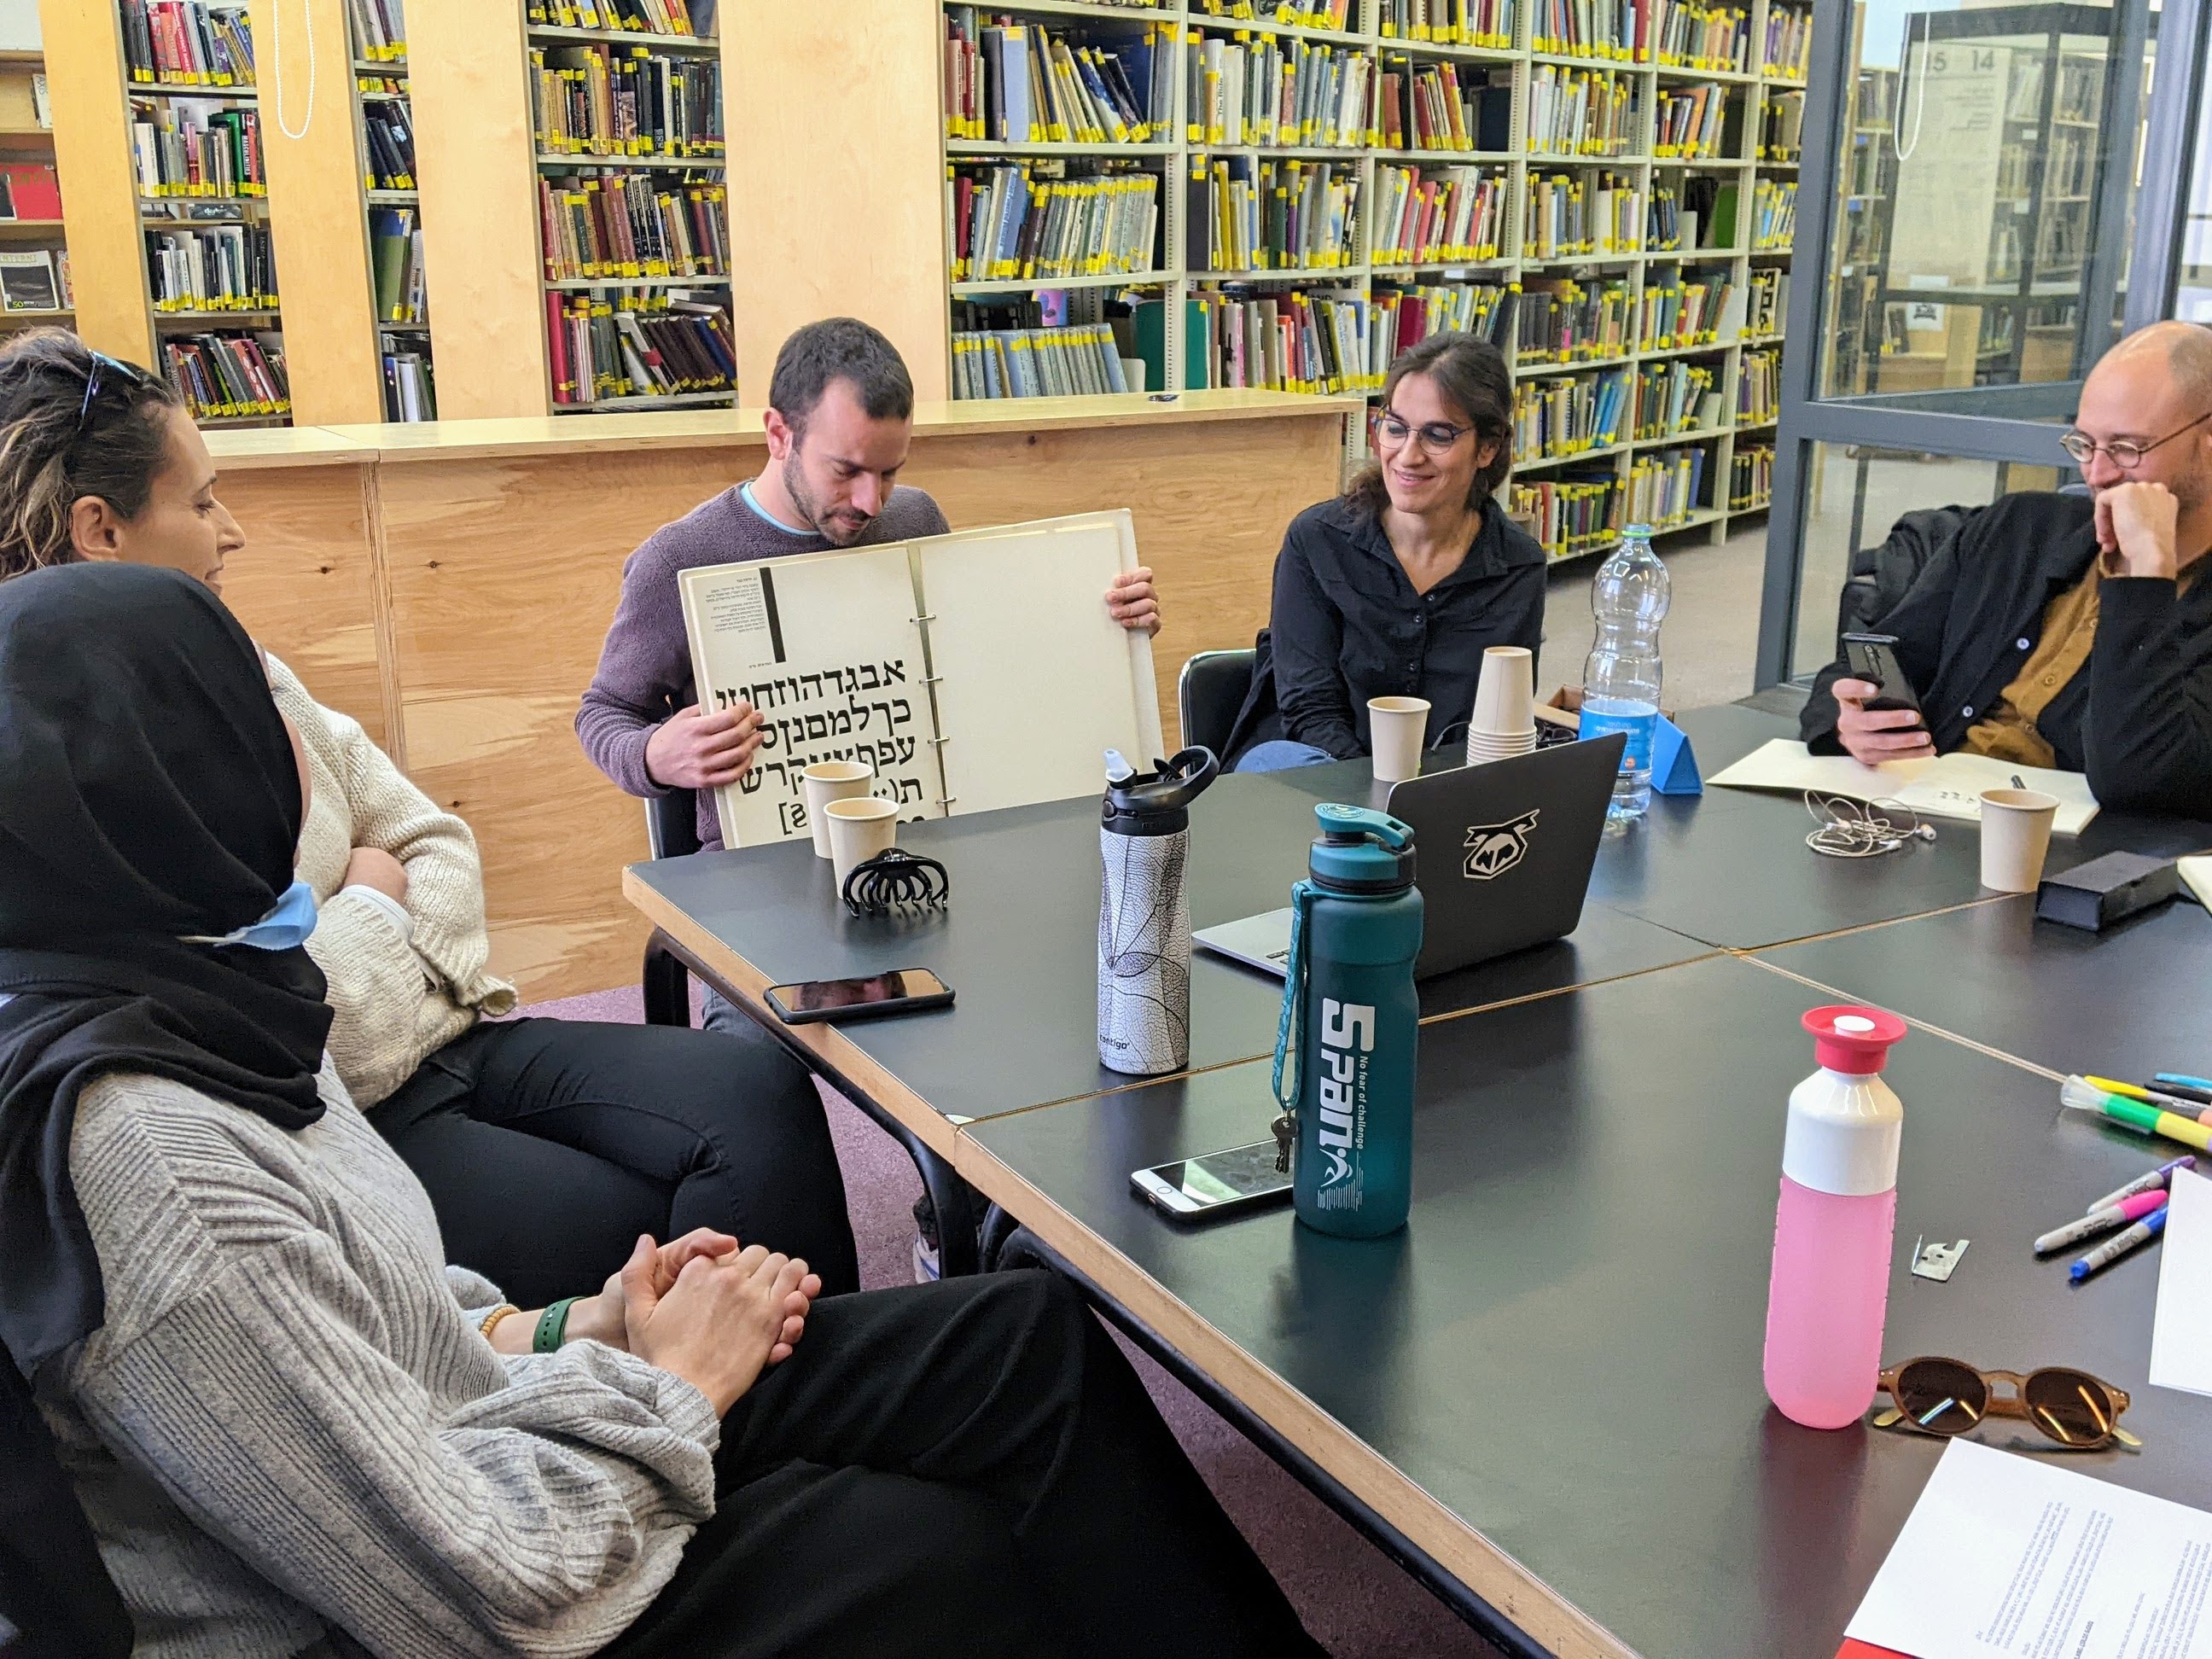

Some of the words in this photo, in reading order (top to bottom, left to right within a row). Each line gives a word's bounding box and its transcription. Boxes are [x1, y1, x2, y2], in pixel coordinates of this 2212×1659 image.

[1973, 49, 1994, 72] 14
[1359, 1056, 1369, 1069] No
[1359, 1069, 1367, 1091] fear
[1358, 1092, 1367, 1104] of
[1355, 1104, 1366, 1150] challenge
